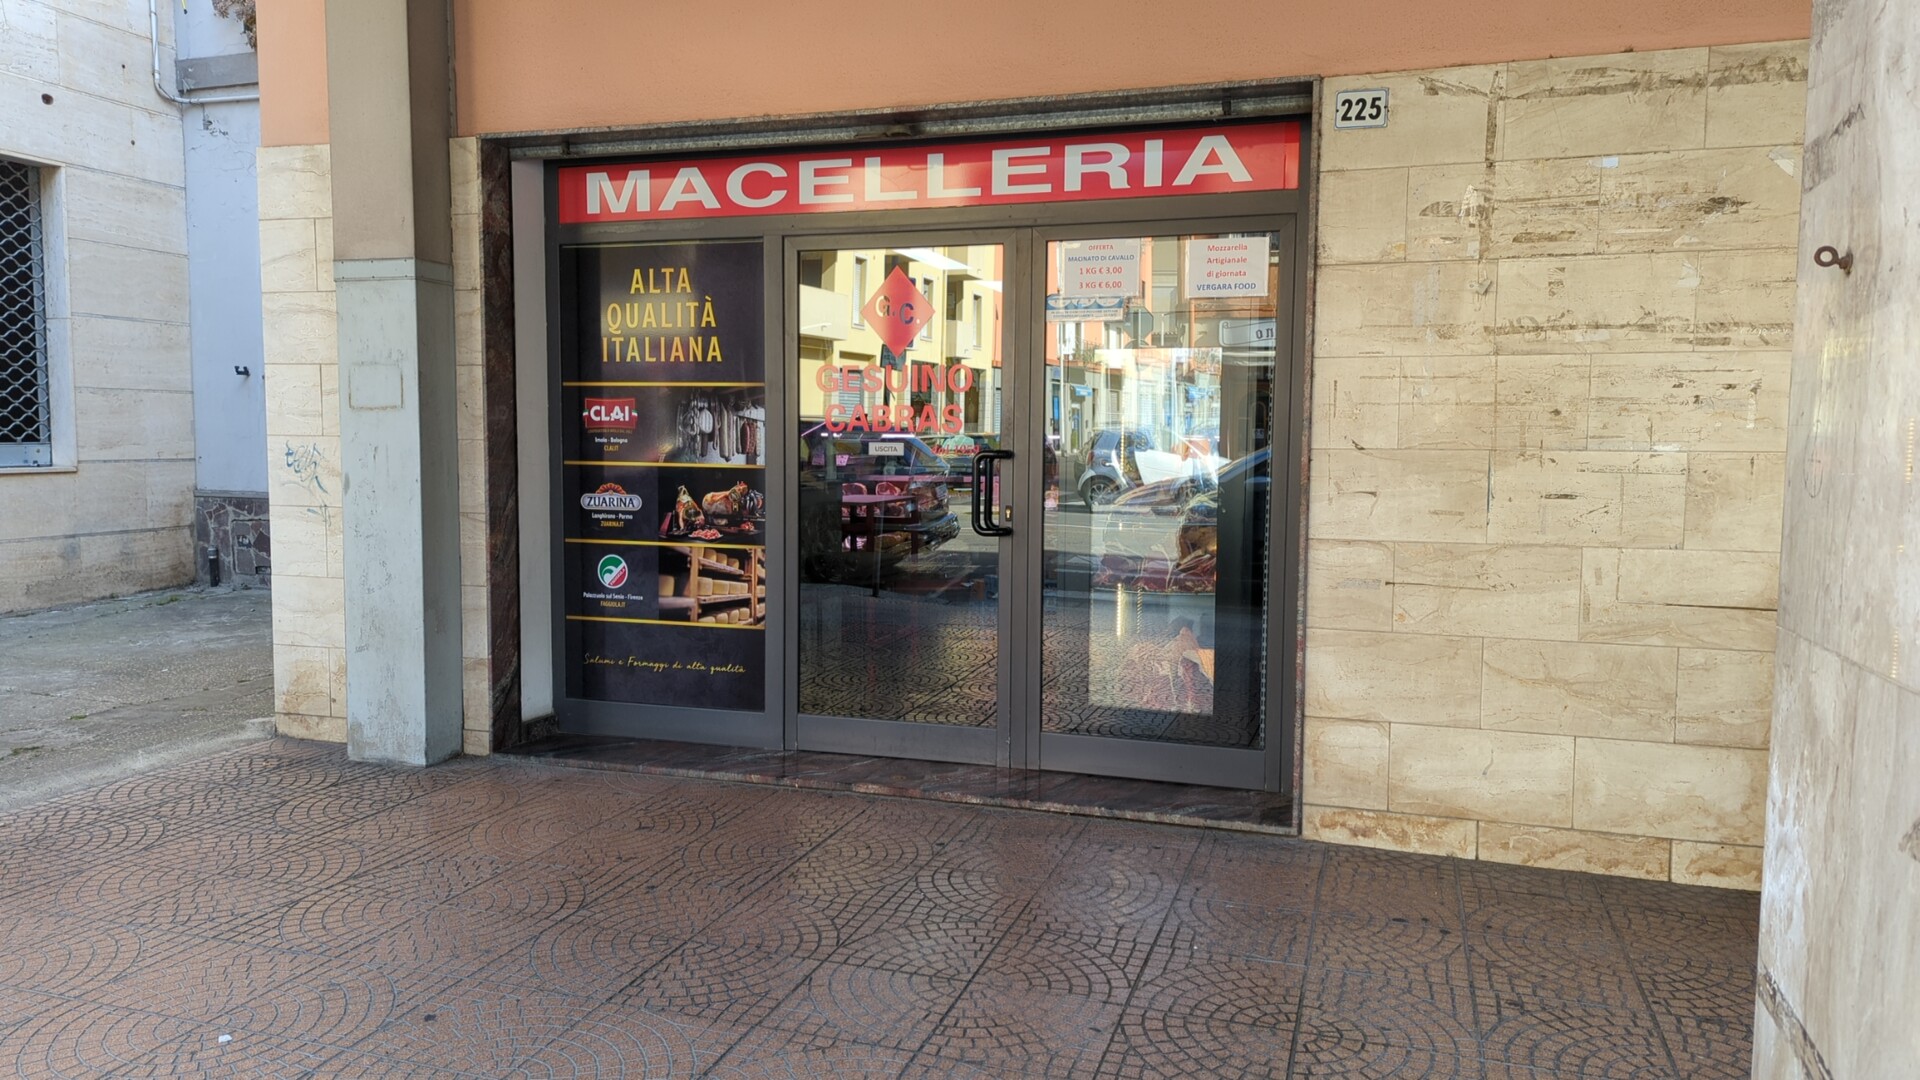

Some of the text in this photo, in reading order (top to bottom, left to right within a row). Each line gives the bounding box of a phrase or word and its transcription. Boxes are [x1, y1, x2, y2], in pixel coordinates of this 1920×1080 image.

[1340, 96, 1382, 122] 225
[586, 134, 1252, 214] MACELLERIA
[1207, 243, 1248, 251] Mozzarella
[1206, 256, 1248, 265] Artigianale
[1085, 267, 1097, 275] KG
[1105, 266, 1123, 275] 3,00
[1206, 270, 1247, 279] di giornata
[630, 267, 692, 295] ALTA
[1085, 281, 1097, 289] KG
[1105, 280, 1123, 289] 6,00
[1196, 282, 1257, 291] VERGARA FOOD
[606, 296, 718, 335] QUALITÀ
[601, 336, 723, 363] ITALIANA
[815, 363, 974, 393] GESUINO
[590, 405, 630, 422] CLAI
[824, 403, 964, 433] CABRAS
[874, 444, 899, 454] USCITA
[586, 497, 635, 508] ZUARINA
[583, 653, 615, 665] Salumi
[627, 656, 669, 672] Formaggi
[672, 661, 683, 669] di
[686, 661, 706, 670] alta
[710, 664, 747, 675] qualità
